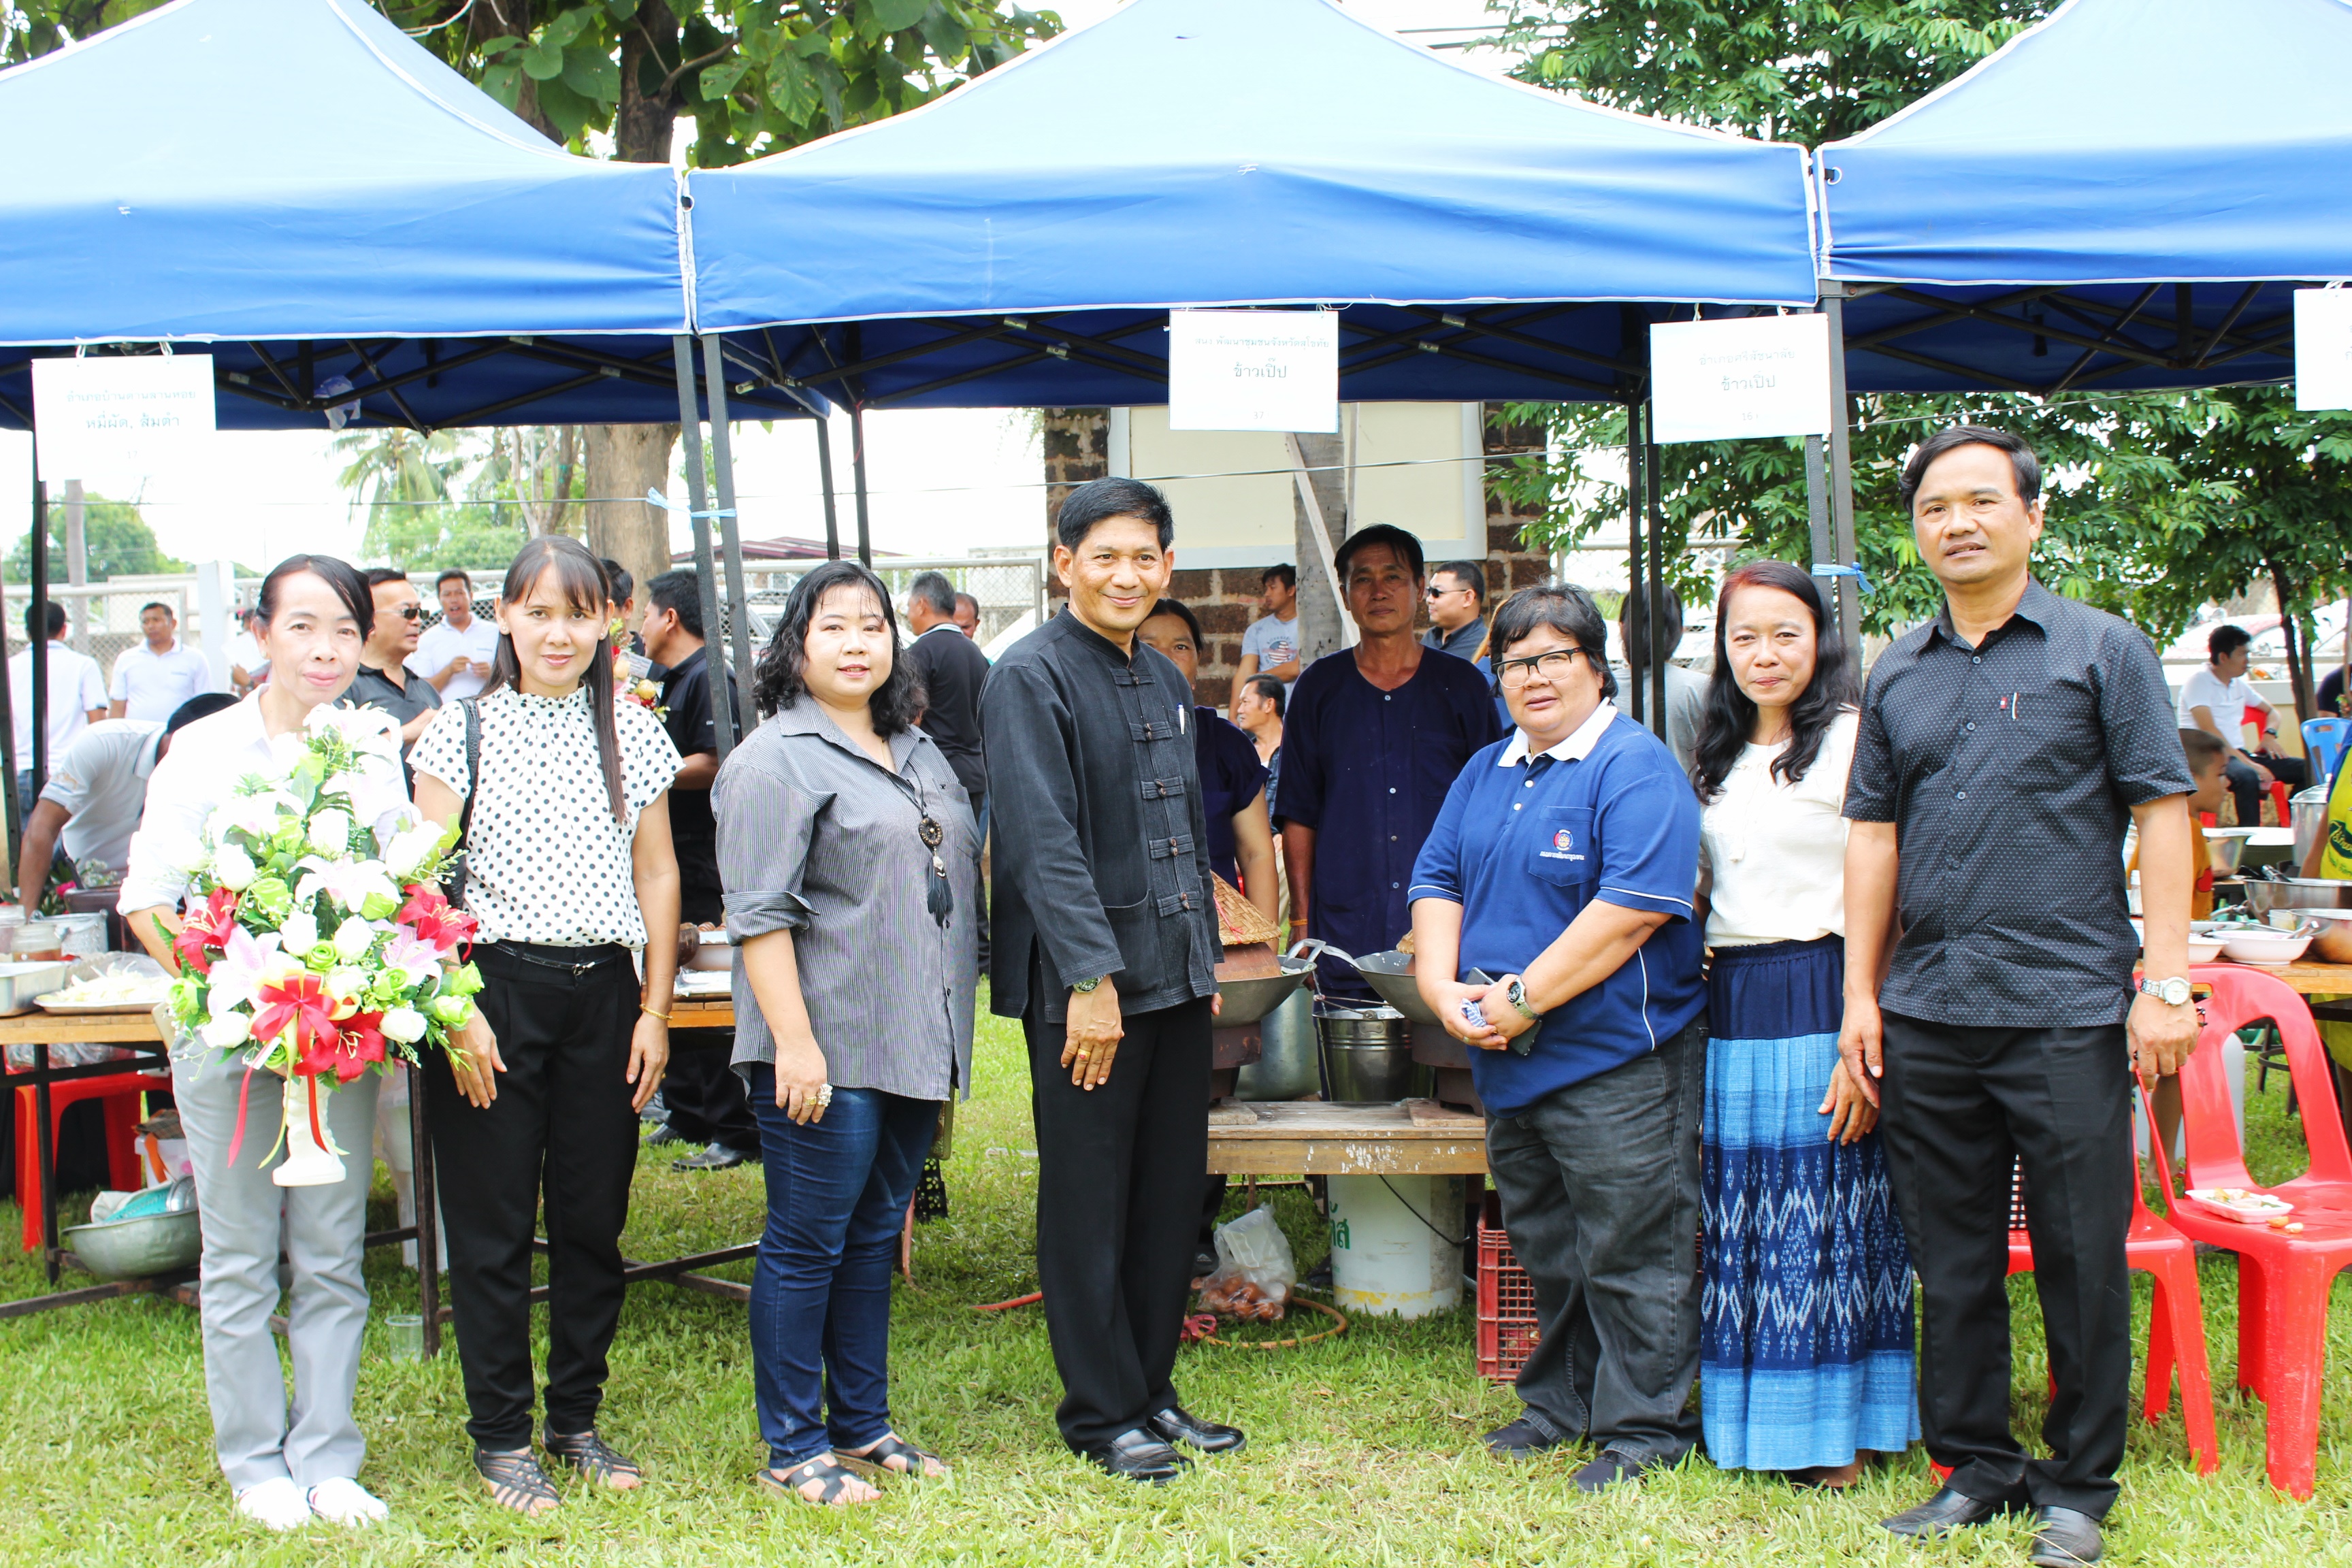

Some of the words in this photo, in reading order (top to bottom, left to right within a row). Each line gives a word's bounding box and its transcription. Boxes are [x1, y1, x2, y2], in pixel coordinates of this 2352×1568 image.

[1699, 348, 1795, 365] อำเภอศรีสัชนาลัย
[1233, 357, 1287, 378] ข้าวเปิ๊ป
[140, 411, 180, 428] ส้มตำ
[1253, 411, 1264, 420] 37
[1742, 412, 1753, 421] 16
